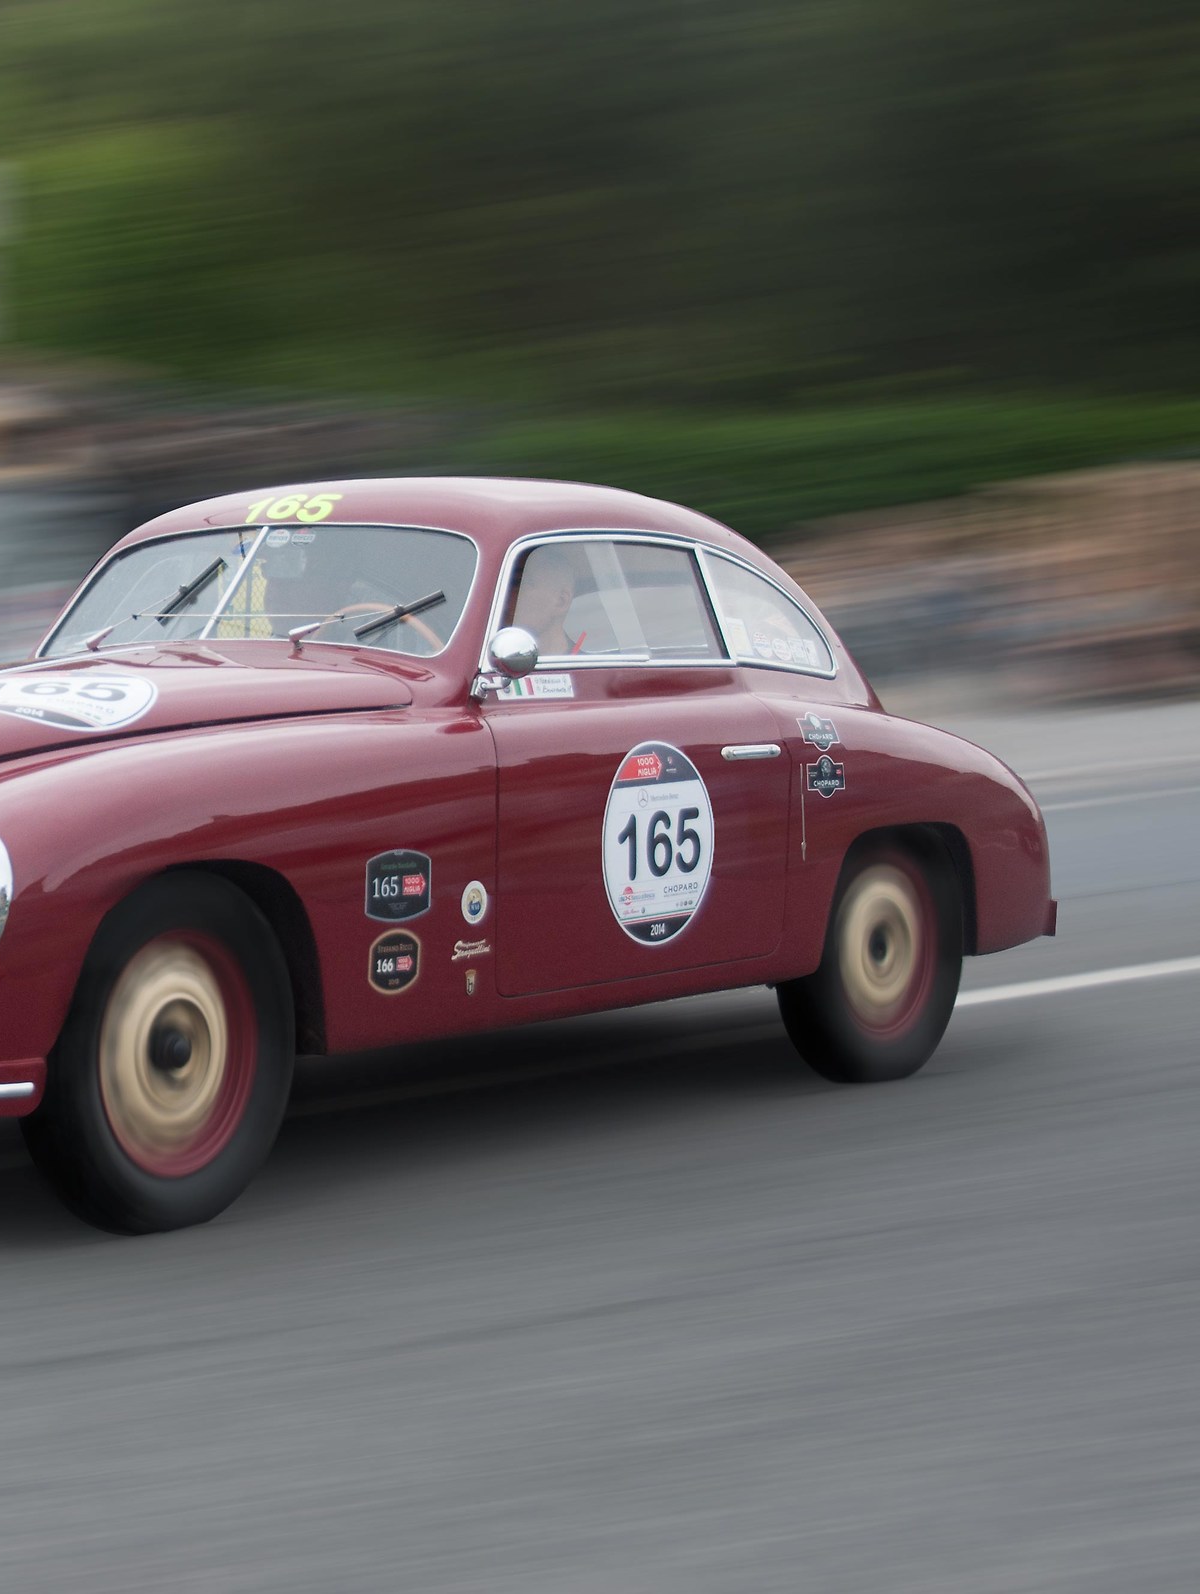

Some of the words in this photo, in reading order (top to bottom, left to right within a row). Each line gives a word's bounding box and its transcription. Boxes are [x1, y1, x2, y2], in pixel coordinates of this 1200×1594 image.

[245, 494, 343, 523] 165
[15, 706, 44, 718] 2014
[637, 757, 654, 766] 1000
[637, 767, 657, 777] MIGLIA
[813, 779, 839, 787] CHOPARD
[617, 807, 701, 881] 165
[372, 876, 399, 898] 165
[404, 877, 420, 885] 1000
[403, 885, 421, 894] MIGLIA
[663, 881, 699, 894] CHOPARD
[650, 923, 666, 935] 2014
[376, 958, 394, 973] 166
